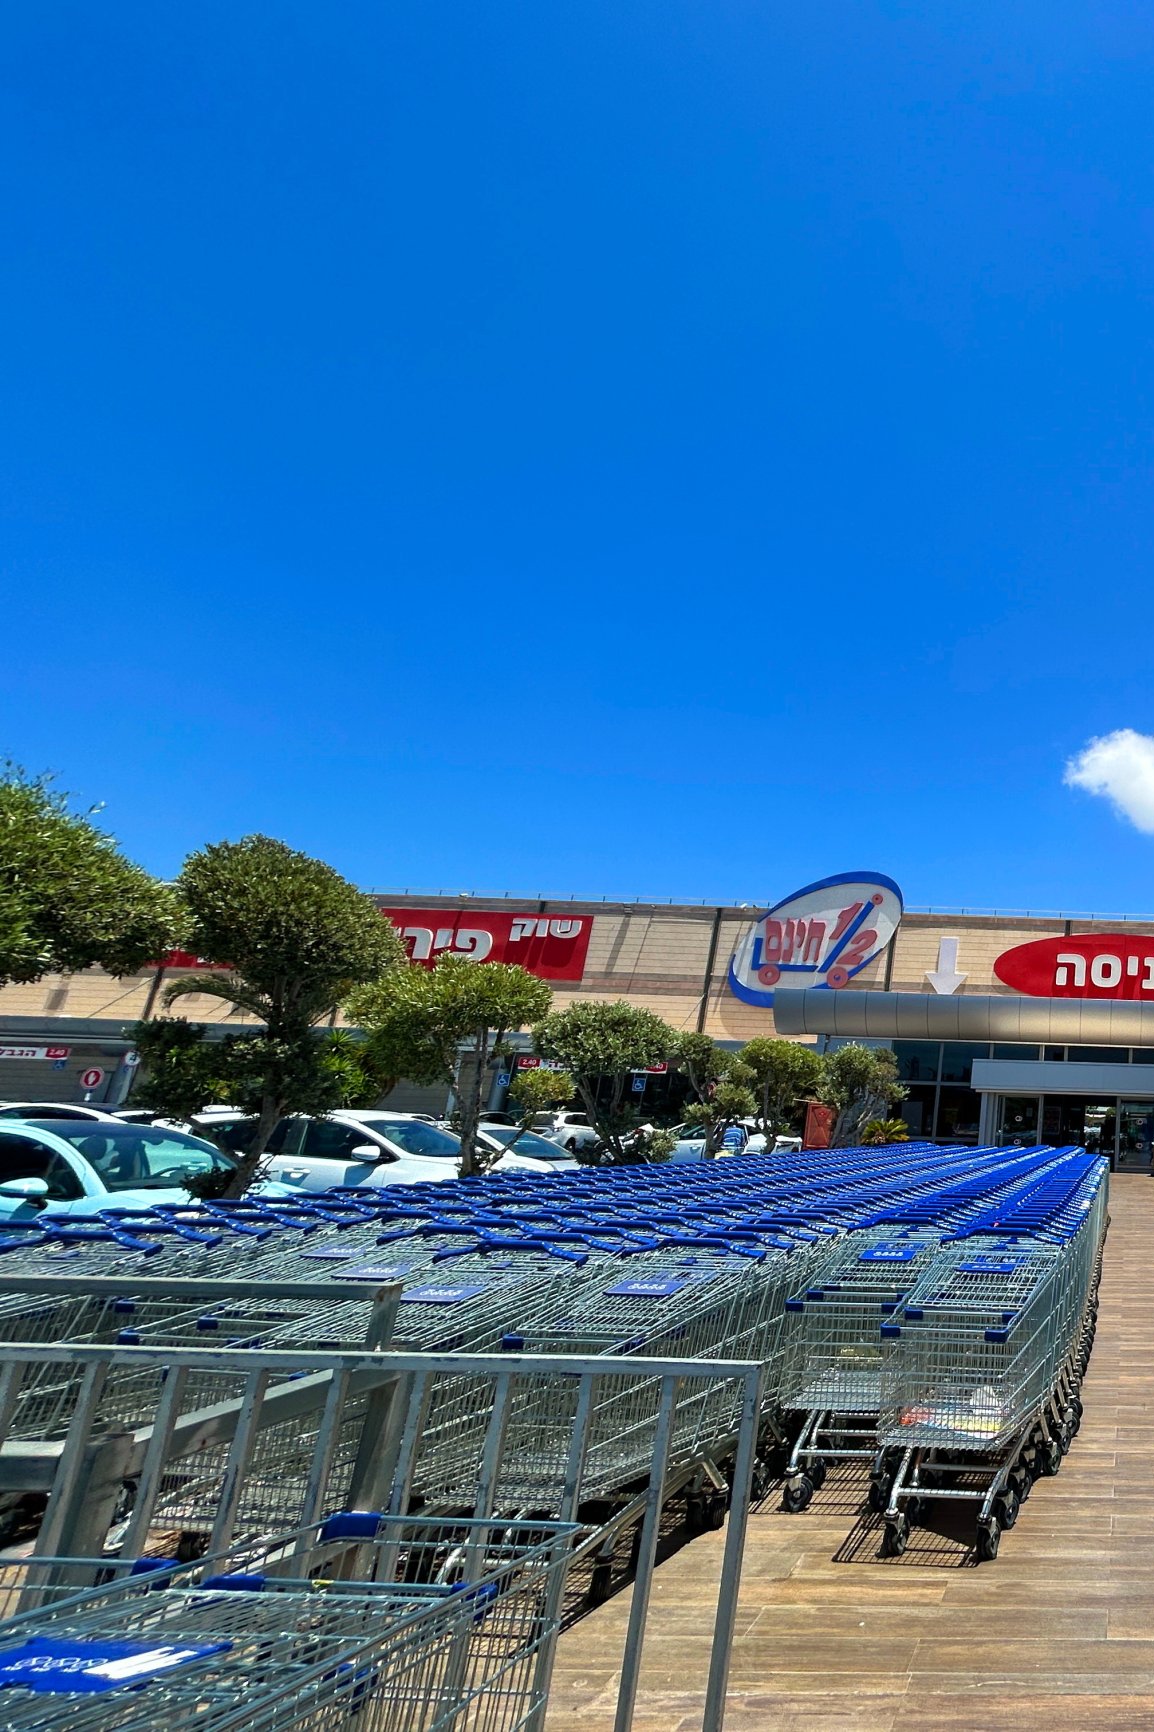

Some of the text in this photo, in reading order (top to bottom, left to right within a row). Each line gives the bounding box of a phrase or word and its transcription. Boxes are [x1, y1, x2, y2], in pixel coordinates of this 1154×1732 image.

[509, 918, 582, 942] שוק
[765, 917, 826, 962] חינם
[48, 1048, 66, 1056] 2.40
